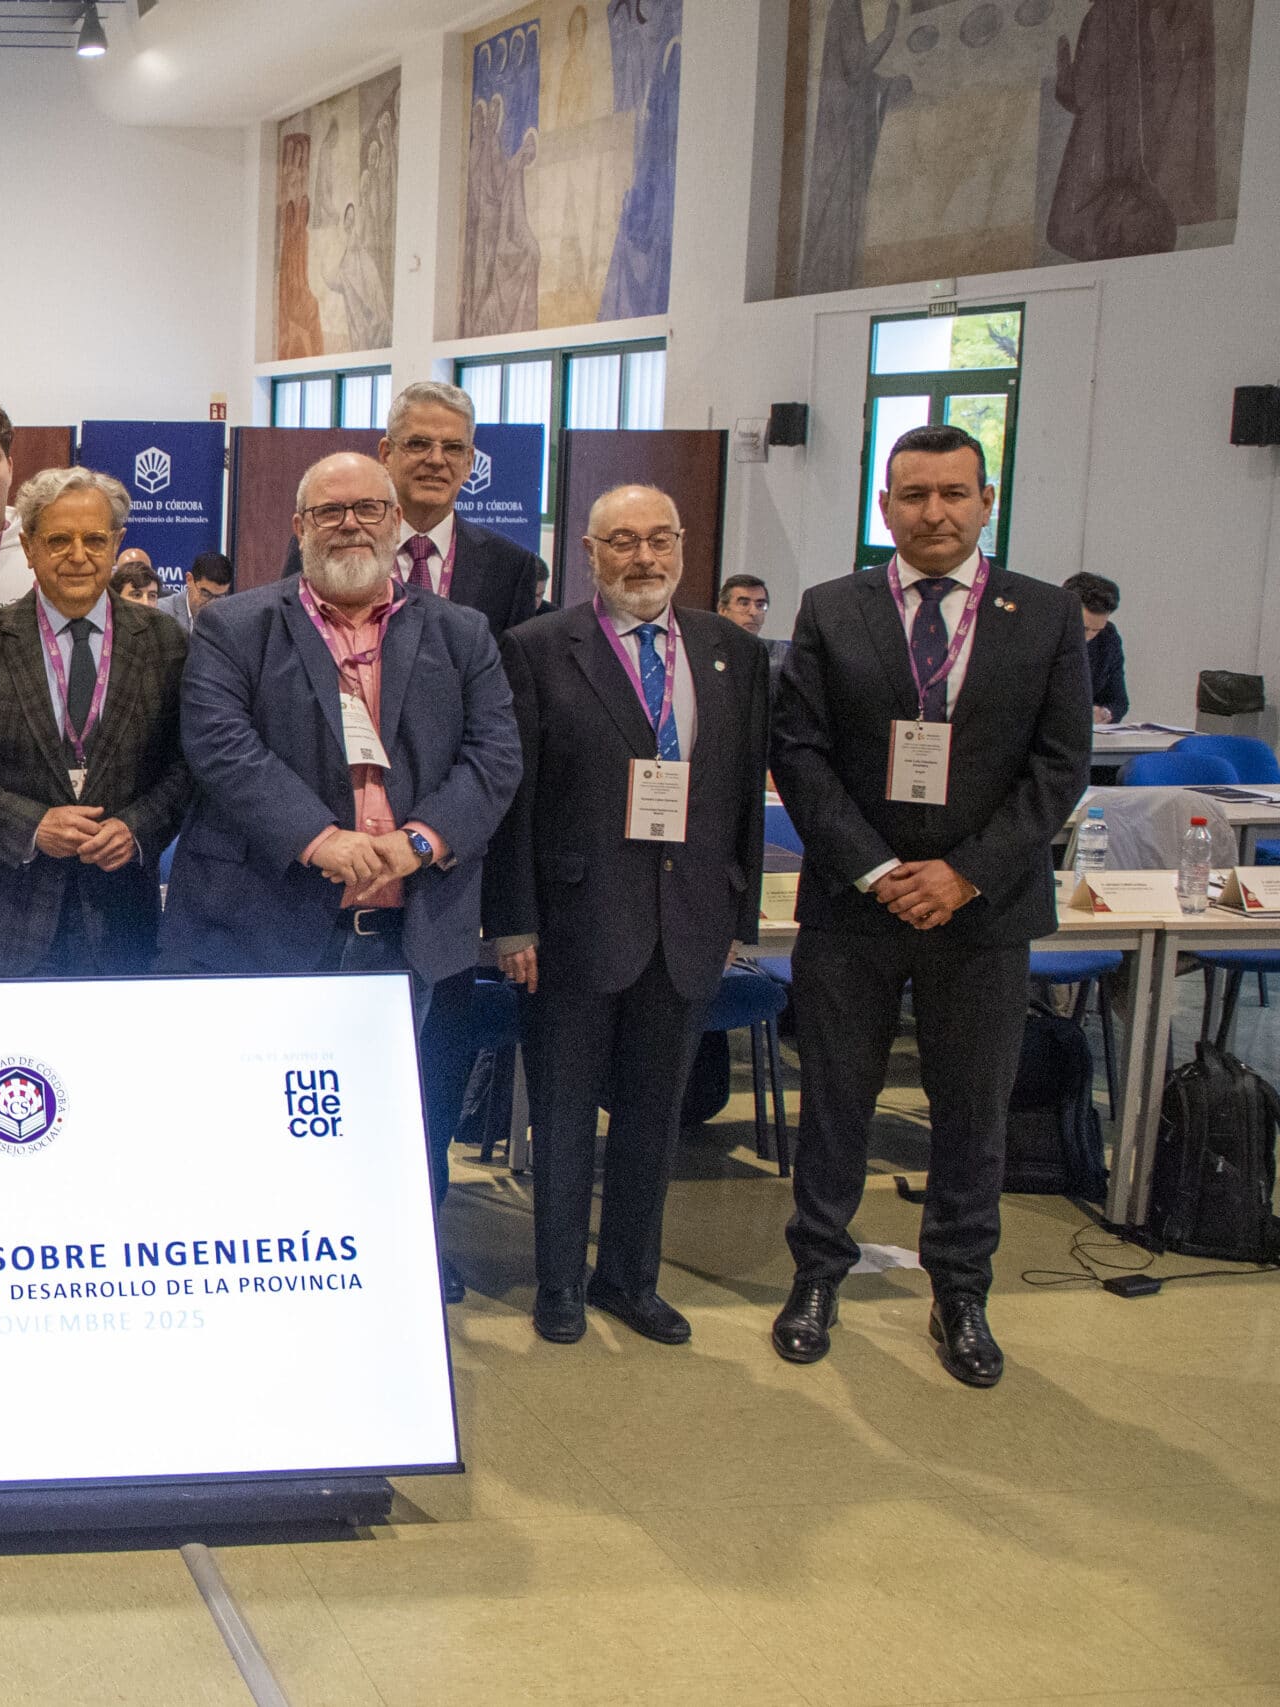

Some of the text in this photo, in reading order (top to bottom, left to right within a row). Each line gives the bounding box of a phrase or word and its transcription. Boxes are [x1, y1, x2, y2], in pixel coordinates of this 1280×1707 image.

[129, 500, 154, 511] SIDAD
[165, 499, 203, 511] CÓRDOBA
[485, 500, 523, 511] CÓRDOBA
[175, 515, 209, 523] Rabanales
[19, 1056, 35, 1067] DE
[9, 1101, 29, 1115] CS
[28, 1126, 62, 1154] SOCIAL
[124, 1230, 358, 1268] INGENIERÍAS
[10, 1279, 156, 1300] DESARROLLO
[166, 1279, 194, 1296] DE
[204, 1278, 230, 1294] LA
[239, 1273, 363, 1293] PROVINCIA
[143, 1310, 205, 1330] 2025
